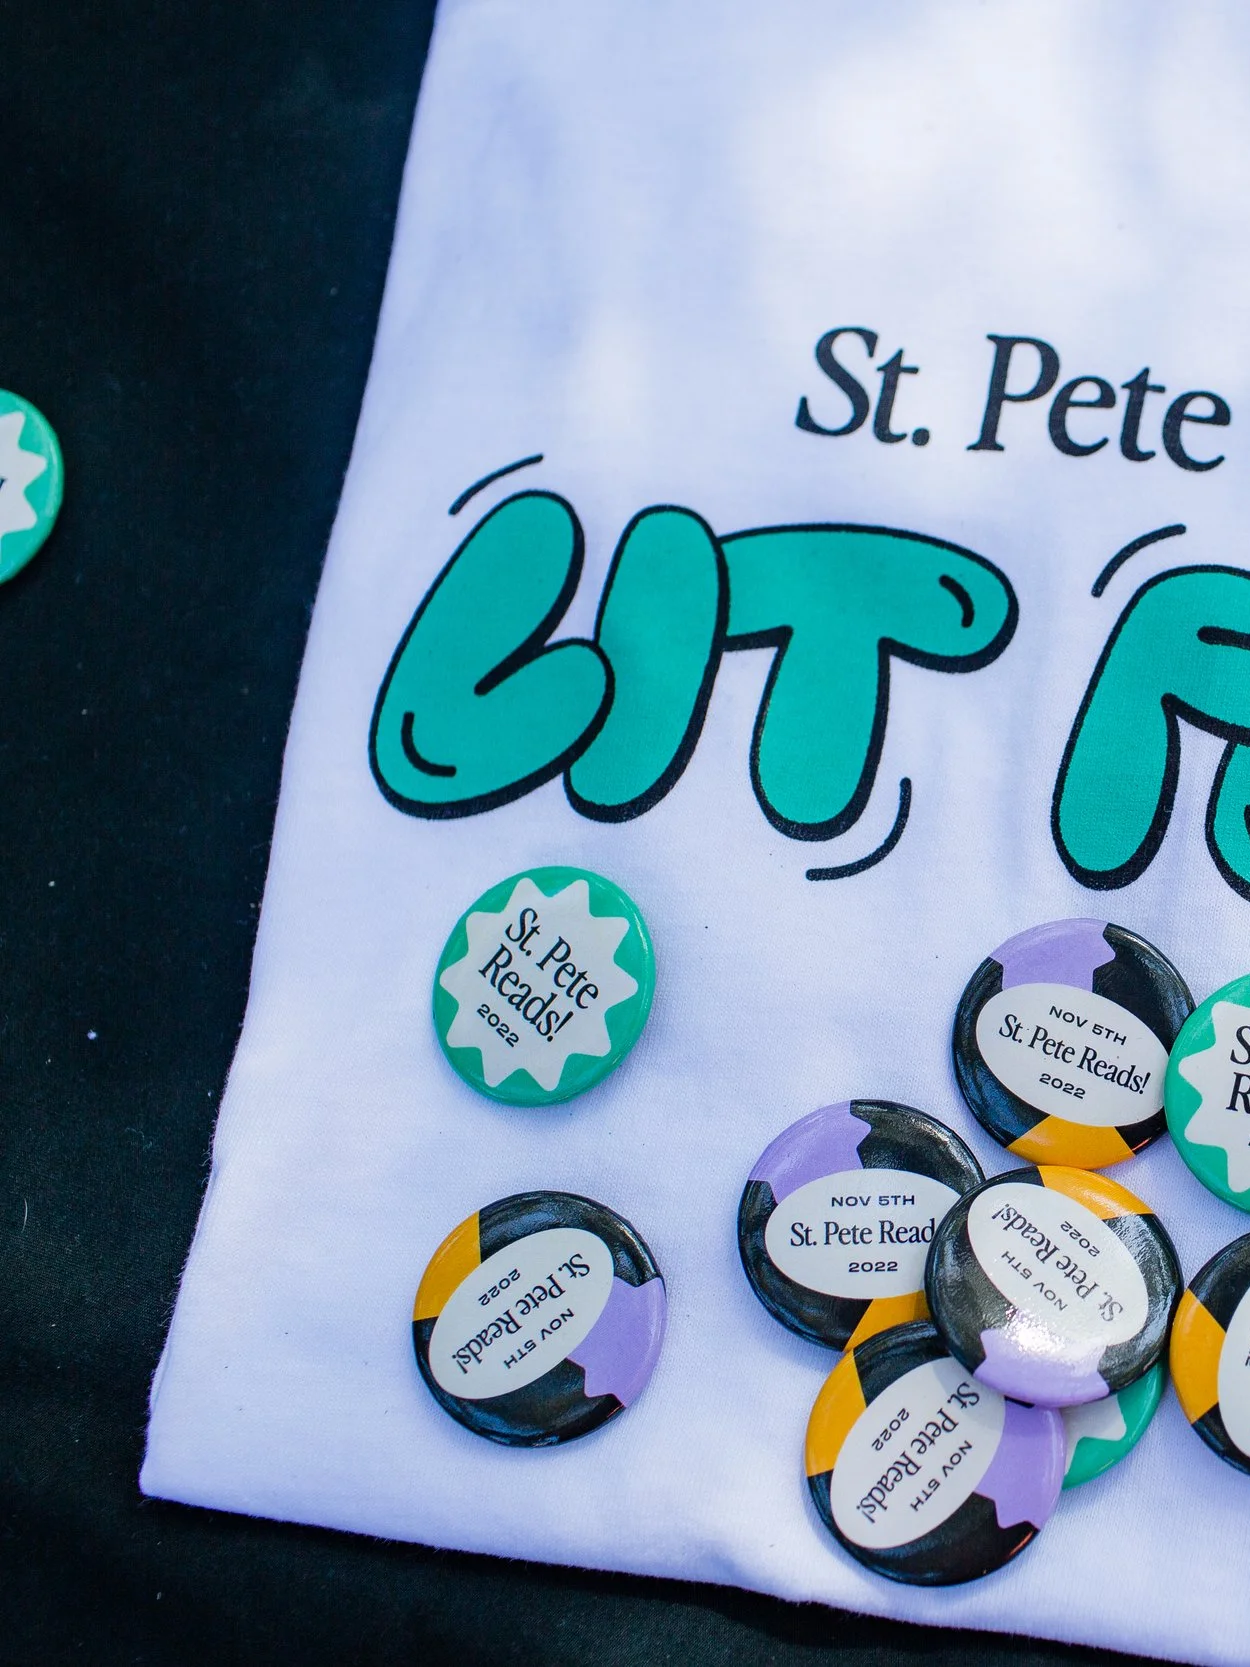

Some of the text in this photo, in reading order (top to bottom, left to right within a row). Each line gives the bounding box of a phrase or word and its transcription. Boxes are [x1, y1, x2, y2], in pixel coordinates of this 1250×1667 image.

[796, 327, 930, 447] St.
[967, 333, 1231, 472] Pete
[369, 489, 1018, 841] LIT
[505, 907, 599, 1009] St. Pete
[478, 943, 574, 1042] Reads!
[477, 1004, 519, 1047] 2022
[999, 1014, 1151, 1094] St. Pete Reads!
[1049, 1005, 1127, 1046] NOV 5TH
[1039, 1073, 1086, 1099] 2022
[831, 1195, 915, 1207] NOV 5TH
[790, 1218, 935, 1246] St. Pete Read
[1060, 1221, 1100, 1257] 2022
[478, 1269, 521, 1306] 2022
[848, 1262, 898, 1272] 2022
[991, 1203, 1124, 1322] St. Pete Reads!
[1001, 1251, 1068, 1311] NOV 5TH
[452, 1254, 590, 1374] St. Pete Reads!
[503, 1308, 574, 1369] NOV 5TH
[856, 1382, 980, 1523] St. Pete Reads!
[871, 1408, 909, 1451] 2022
[910, 1440, 972, 1511] NOV 5TH
